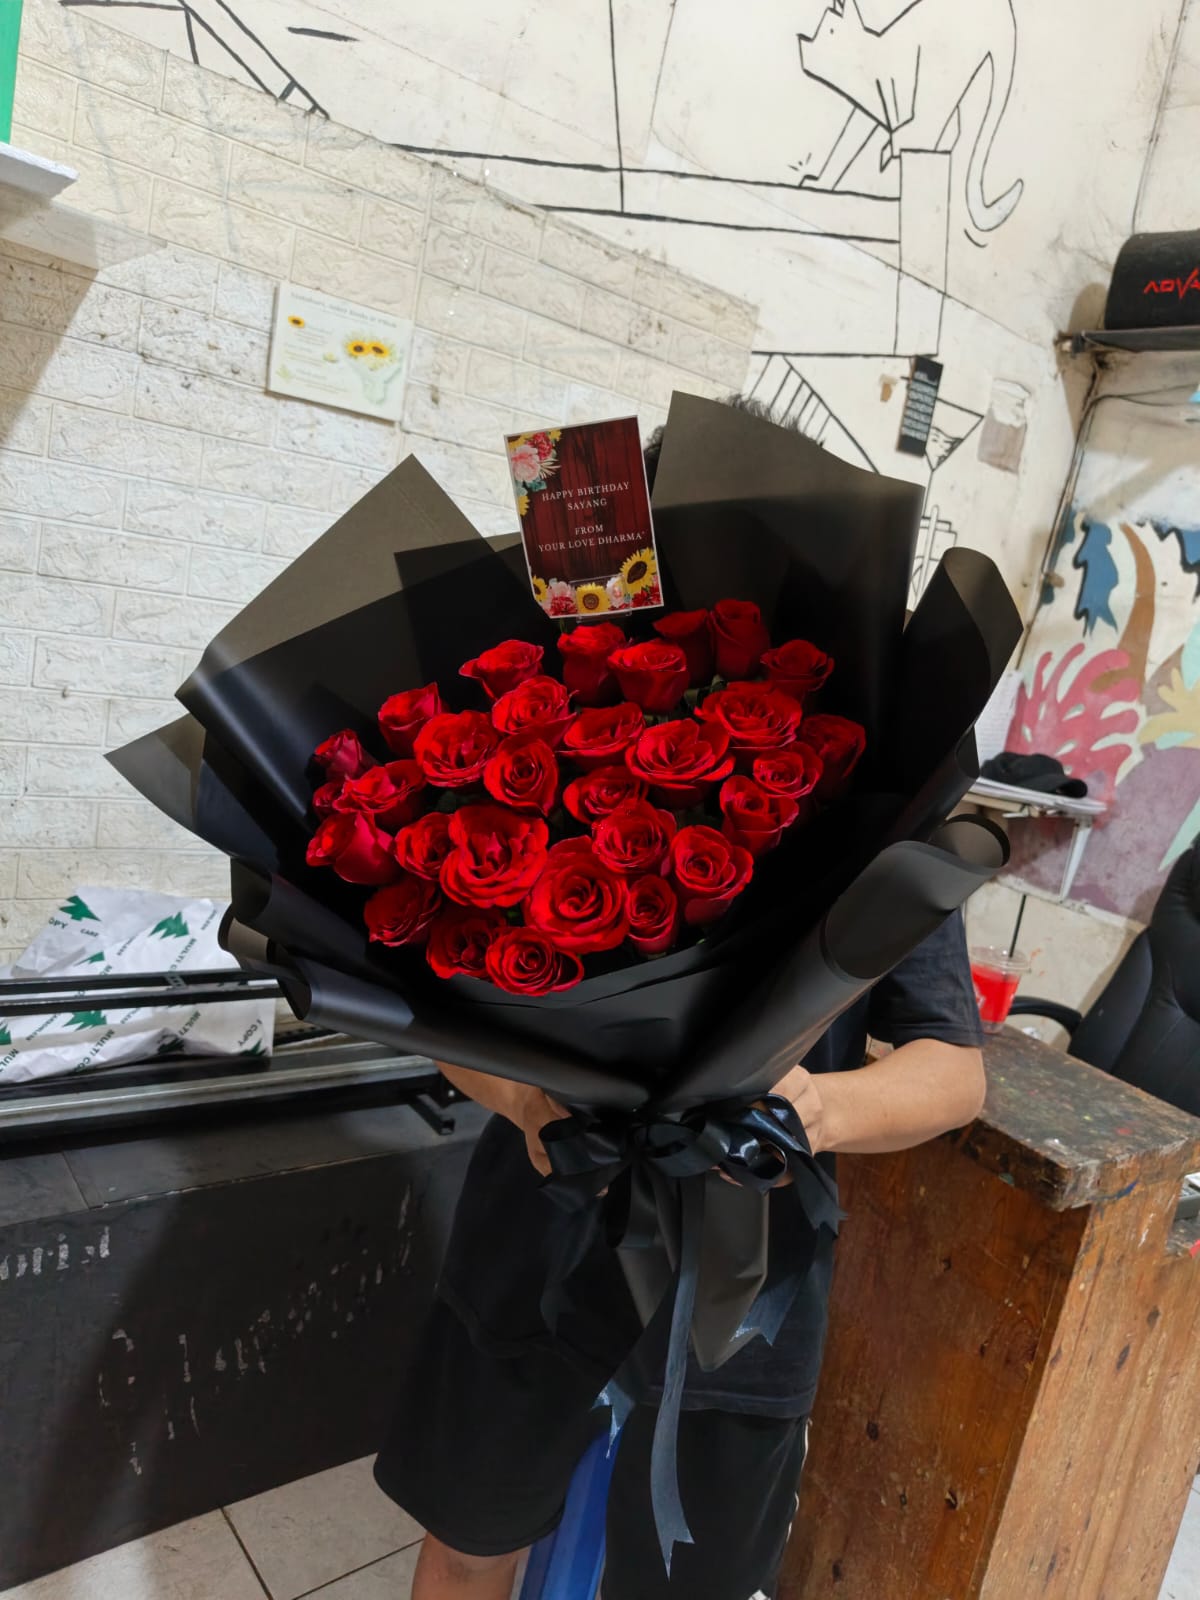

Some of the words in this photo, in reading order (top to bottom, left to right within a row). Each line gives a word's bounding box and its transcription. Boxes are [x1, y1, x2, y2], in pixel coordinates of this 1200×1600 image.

[541, 489, 574, 502] HAPPY
[577, 481, 630, 497] BIRTHDAY
[567, 498, 608, 511] SAYANG
[574, 524, 604, 536] FROM
[538, 542, 566, 553] YOUR
[568, 537, 595, 549] LOVE
[179, 1011, 201, 1036] MULTI
[90, 1028, 115, 1056] MULTI
